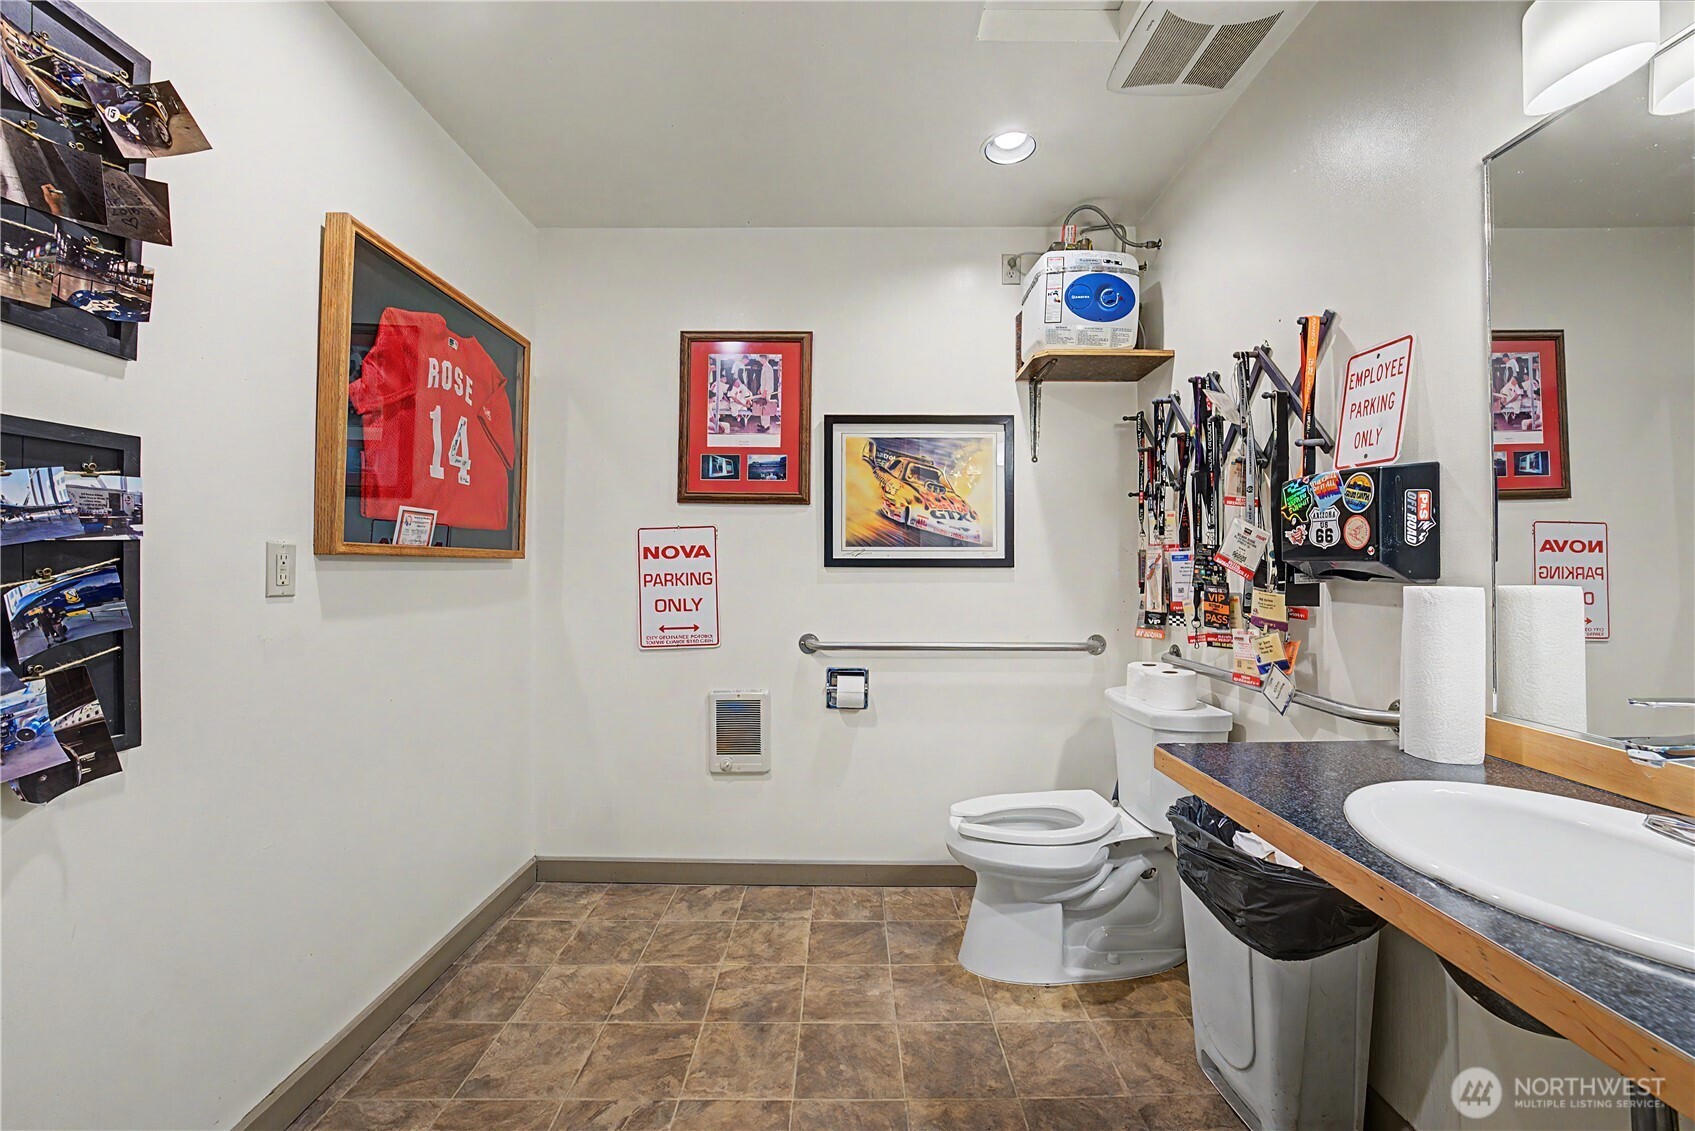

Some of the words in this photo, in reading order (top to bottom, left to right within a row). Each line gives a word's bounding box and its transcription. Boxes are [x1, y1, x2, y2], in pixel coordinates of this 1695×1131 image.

[107, 108, 117, 119] 15
[1348, 356, 1405, 390] EMPLOYEE
[427, 357, 473, 406] ROSE
[1349, 392, 1396, 420] PARKING
[429, 404, 472, 486] 14
[1354, 427, 1383, 449] ONLY
[1419, 493, 1429, 519] P&S
[929, 510, 972, 522] GTX
[1313, 511, 1336, 519] ARIZONA
[1320, 521, 1328, 529] US
[1315, 528, 1334, 543] 66
[643, 545, 711, 559] NOVA
[643, 572, 713, 587] PARKING
[654, 598, 703, 612] ONLY
[1207, 593, 1225, 603] VIP
[1205, 613, 1229, 625] PASS
